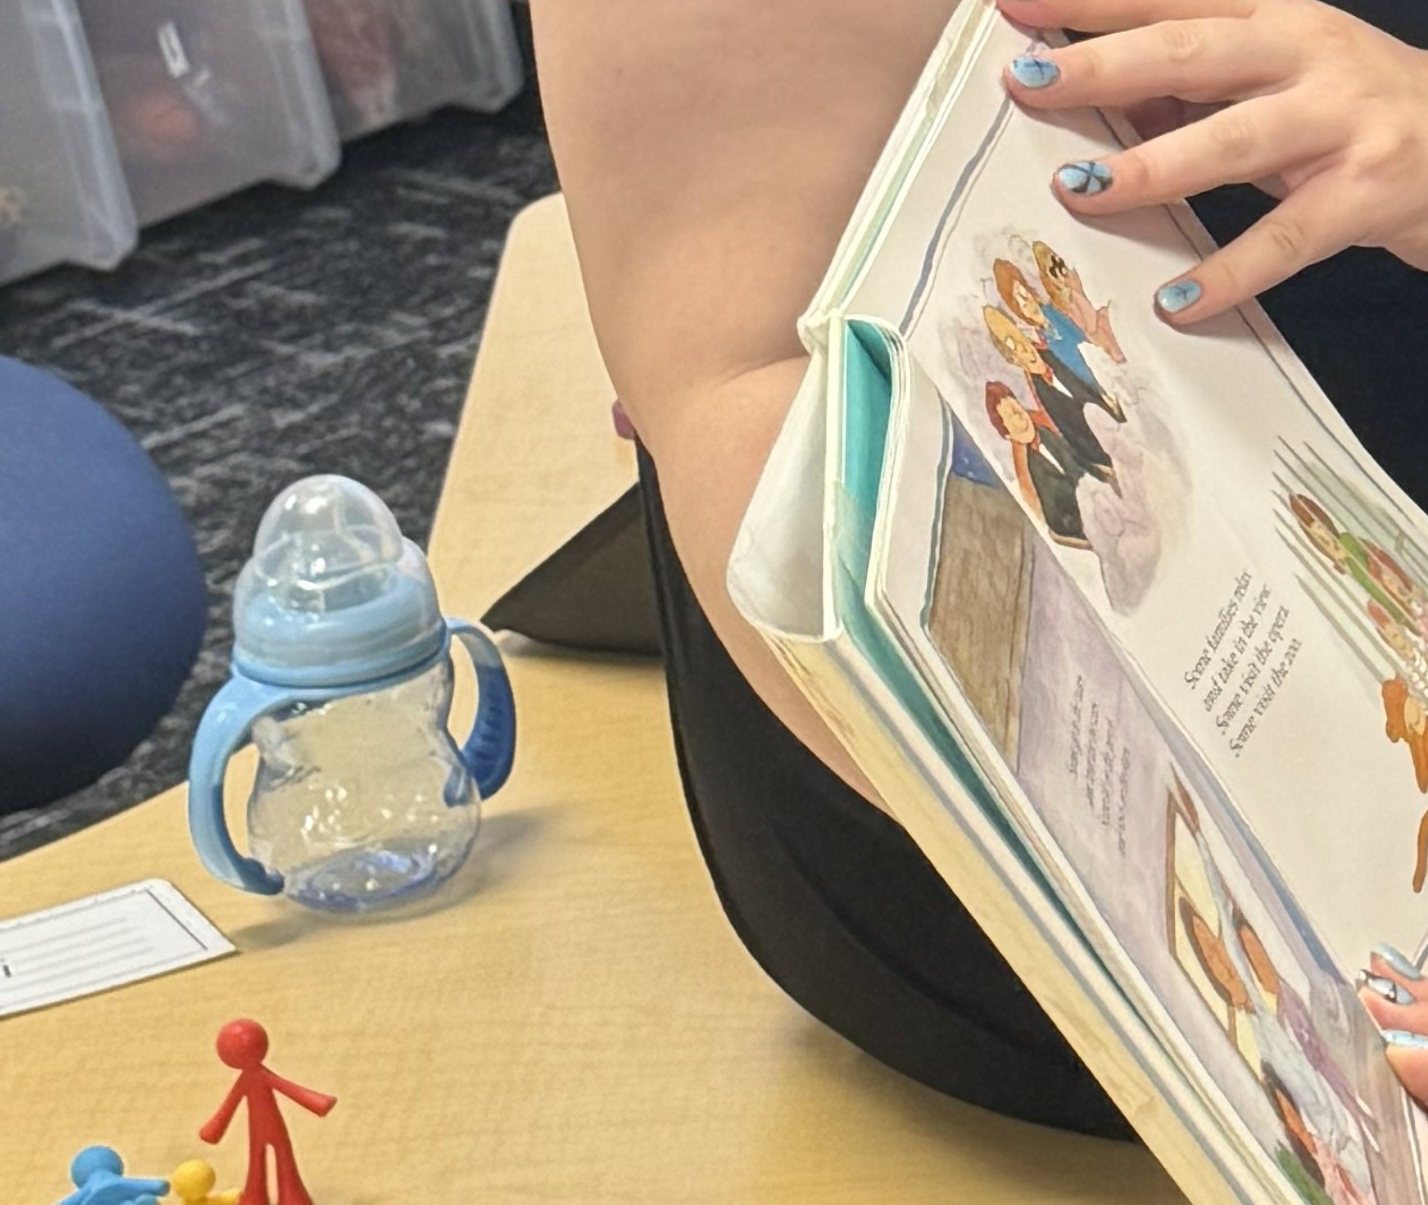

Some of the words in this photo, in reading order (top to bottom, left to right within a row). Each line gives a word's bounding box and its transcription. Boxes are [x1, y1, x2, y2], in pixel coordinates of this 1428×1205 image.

[1240, 614, 1258, 638] the
[1184, 648, 1211, 691] Some
[1206, 599, 1238, 653] families
[1232, 636, 1248, 655] in
[1212, 651, 1238, 686] take
[1203, 677, 1223, 713] and
[1215, 692, 1243, 736] Some
[1239, 662, 1261, 694] visit
[1254, 640, 1273, 666] the
[1229, 715, 1257, 759] Some
[1253, 683, 1276, 716] visit
[1270, 661, 1289, 688] the
